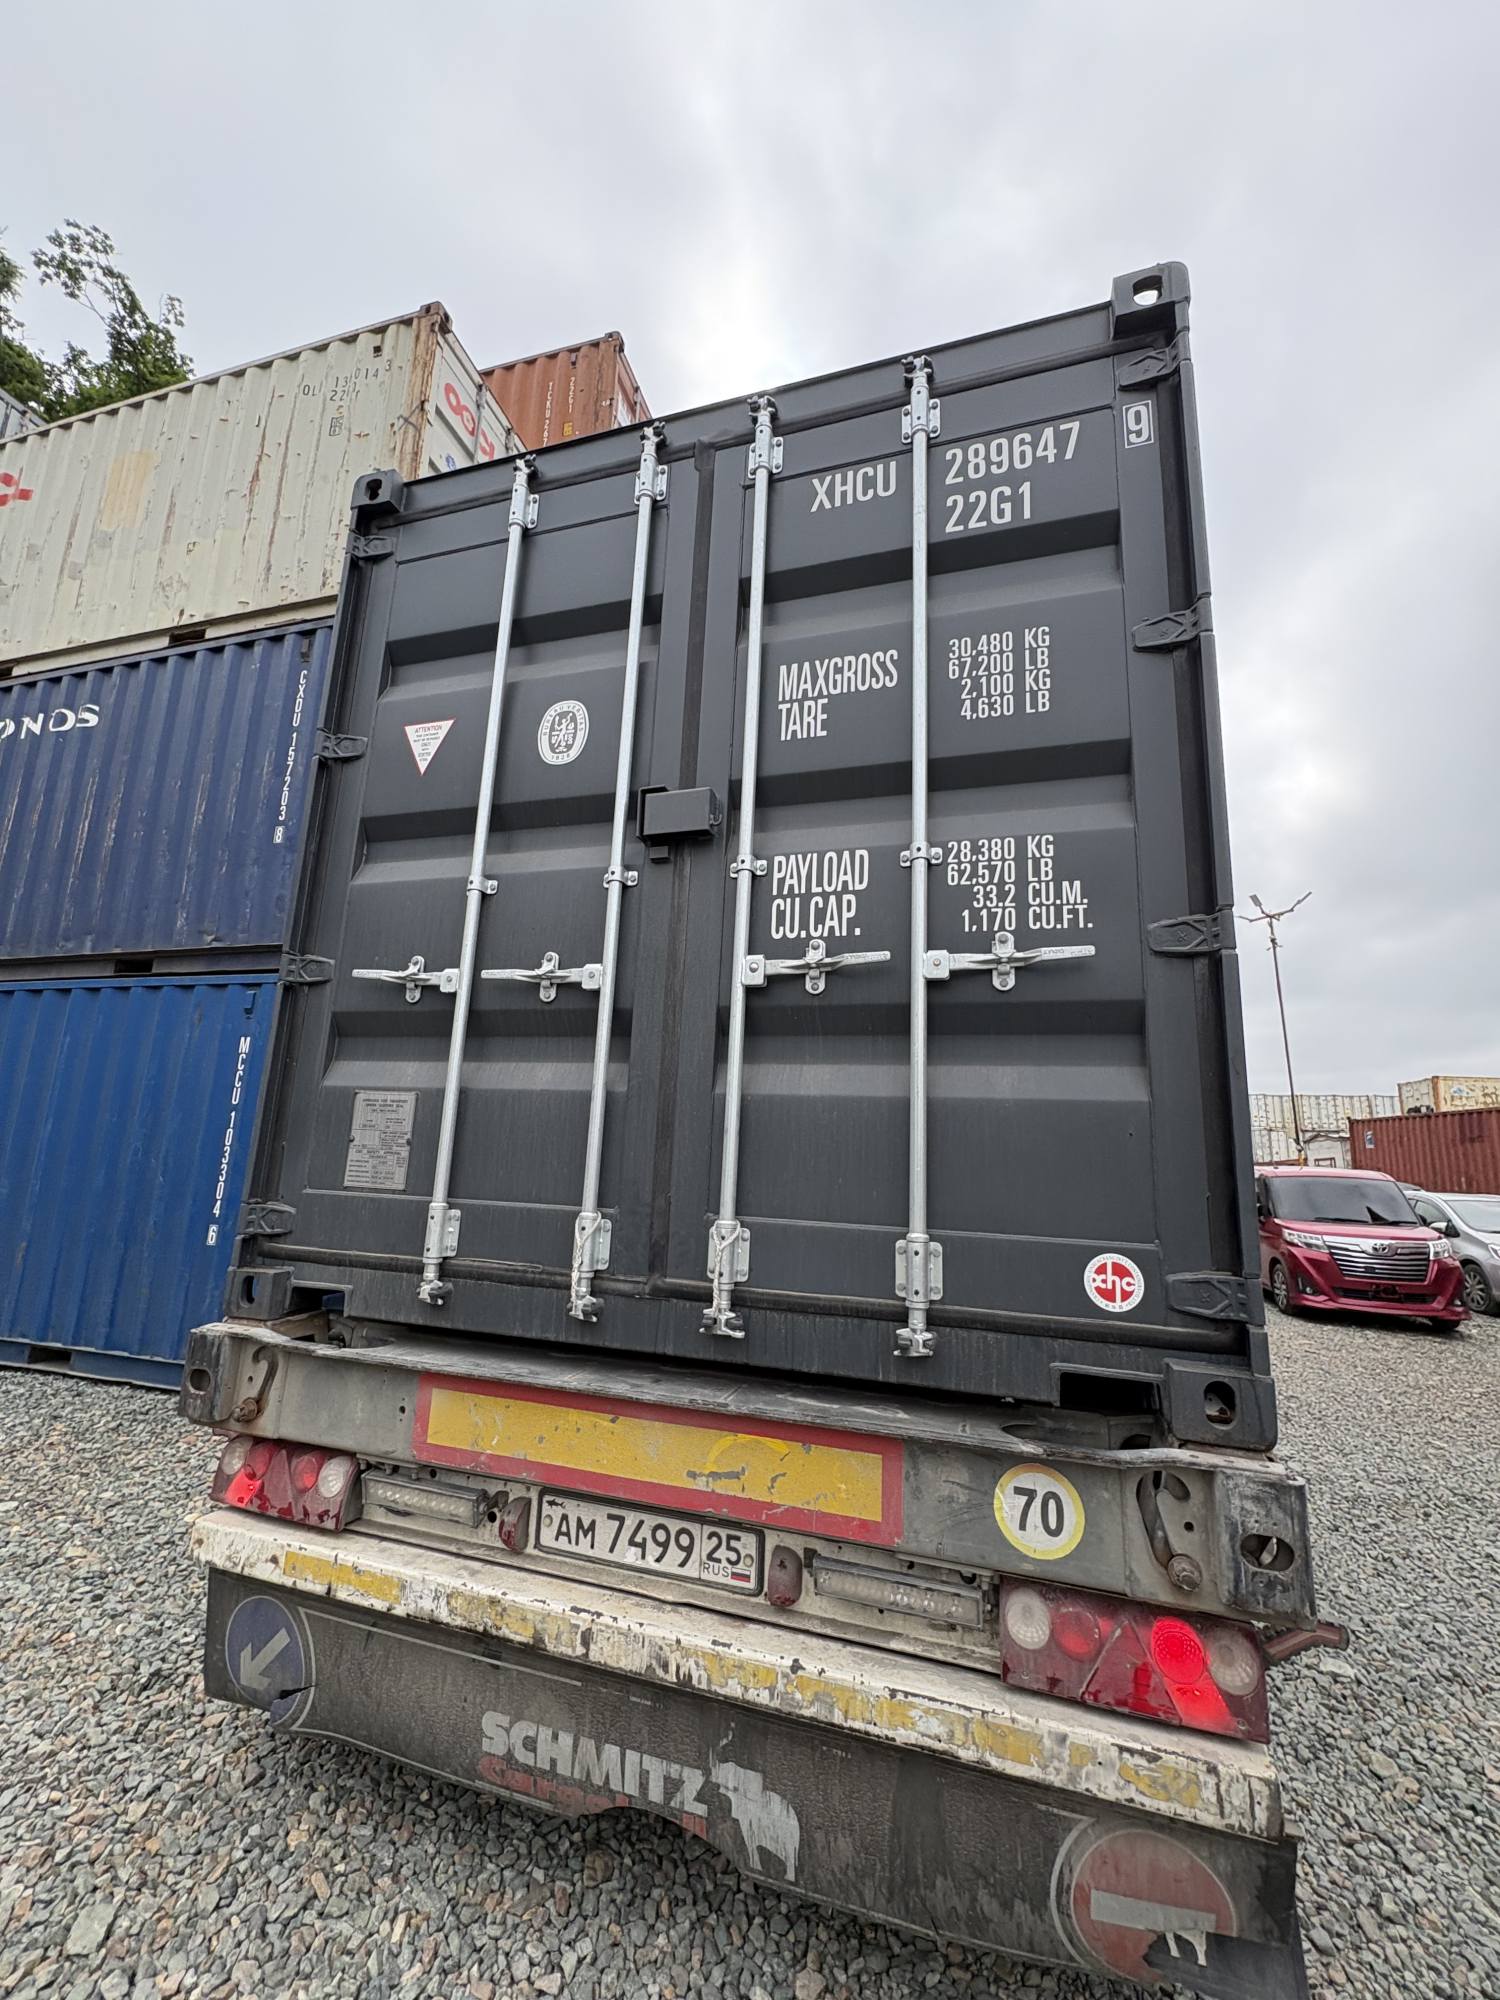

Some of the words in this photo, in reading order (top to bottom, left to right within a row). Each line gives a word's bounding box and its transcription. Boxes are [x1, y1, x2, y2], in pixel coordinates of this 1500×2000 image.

[810, 461, 896, 512] XHCU
[945, 421, 1079, 486] 289647
[1126, 404, 1150, 444] 9
[945, 481, 1031, 533] 22G1
[949, 631, 1014, 659] 30,480
[1025, 626, 1050, 648] KG
[778, 649, 898, 701] MAXGROSS
[949, 652, 1014, 679] 67,200
[1025, 647, 1049, 669] LB
[961, 673, 1014, 699] 2,100
[1025, 669, 1051, 691] KG
[778, 698, 828, 741] TARE
[961, 695, 1014, 720] 4,630
[1026, 691, 1050, 713] LB
[279, 732, 297, 820] 157203
[274, 827, 284, 843] 8
[948, 837, 1015, 863] 28,380
[1027, 835, 1054, 858] KG
[772, 849, 869, 895] PAYLOAD
[948, 860, 1015, 885] 62,570
[1028, 858, 1053, 881] LB
[973, 884, 1016, 907] 33.2
[1028, 880, 1088, 905] CU.M.
[771, 894, 861, 939] CU.CAP.
[962, 908, 1016, 932] 1,170
[1029, 905, 1094, 929] CU.FT.
[232, 1036, 251, 1104] MCCU
[212, 1111, 235, 1218] 103304
[207, 1226, 218, 1244] 6
[1013, 1486, 1064, 1537] 70
[706, 1531, 742, 1566] 25
[702, 1561, 730, 1578] RUS
[481, 1710, 708, 1817] SCHMITZ
